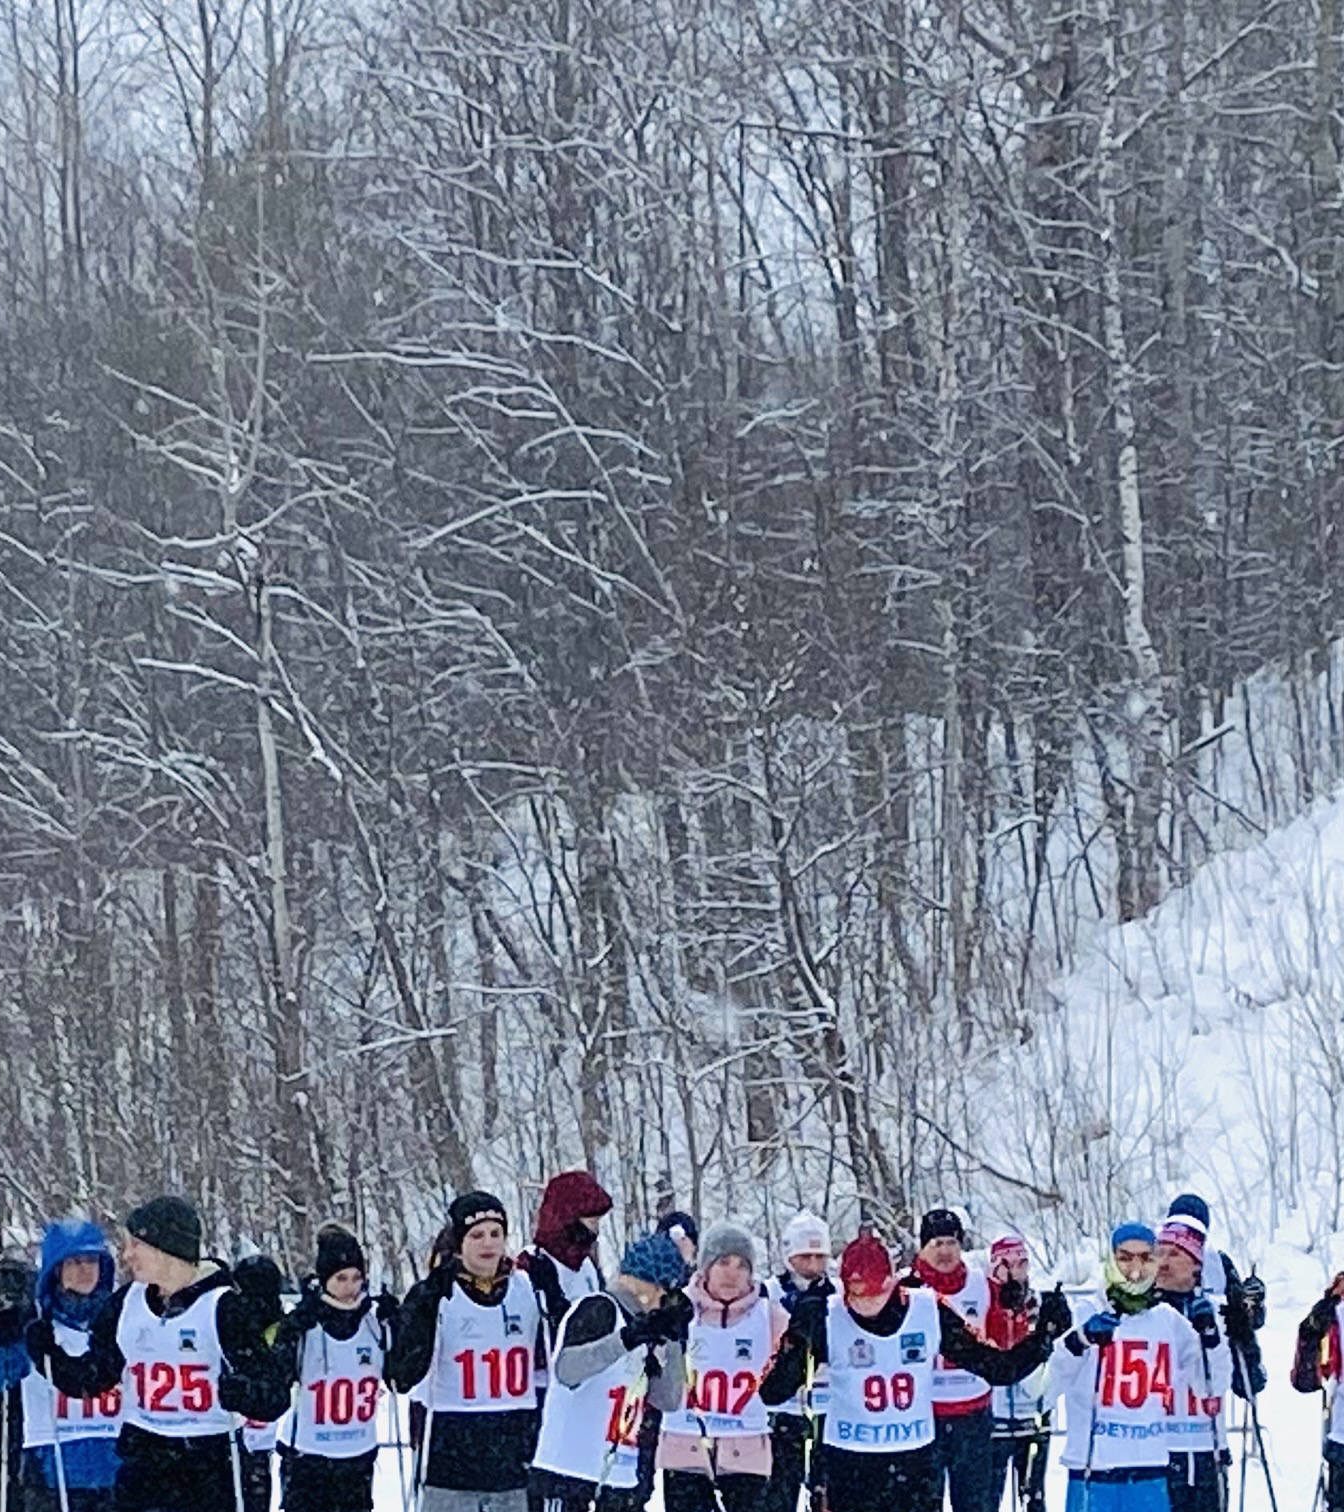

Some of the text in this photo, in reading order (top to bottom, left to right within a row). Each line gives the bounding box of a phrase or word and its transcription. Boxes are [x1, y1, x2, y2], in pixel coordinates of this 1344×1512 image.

[129, 1362, 213, 1412] 125
[454, 1347, 529, 1399] 110
[864, 1373, 914, 1412] 98
[1098, 1340, 1170, 1409] 154
[308, 1376, 378, 1424] 103
